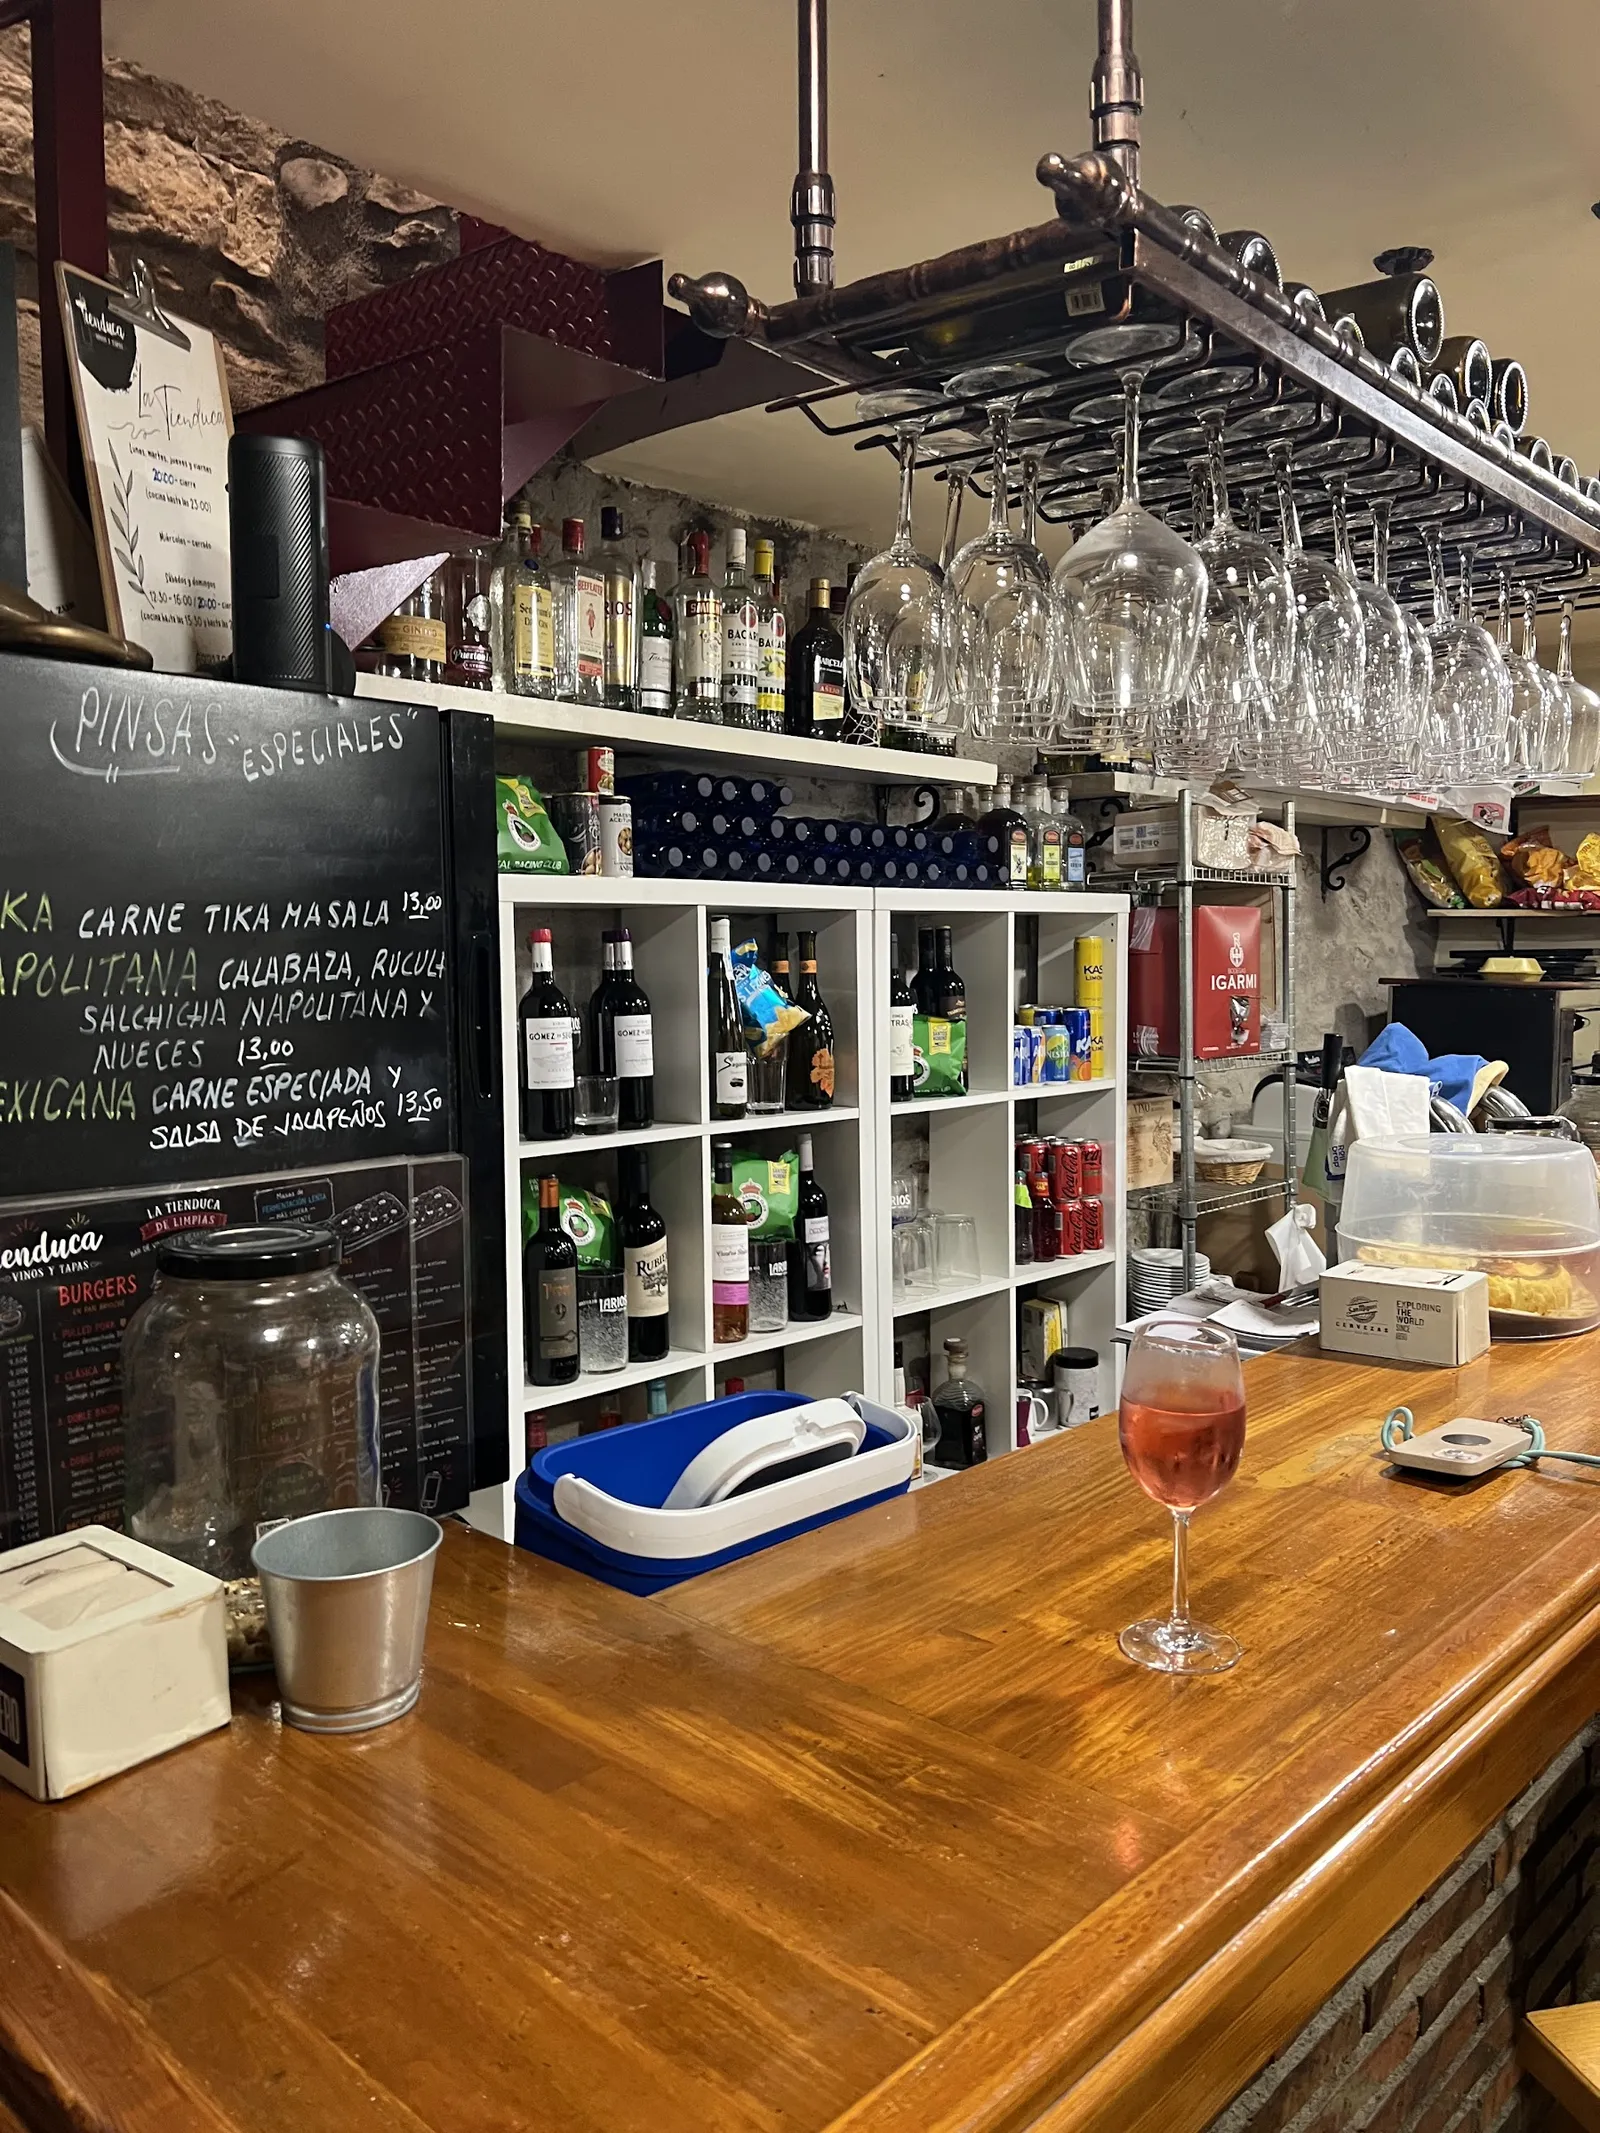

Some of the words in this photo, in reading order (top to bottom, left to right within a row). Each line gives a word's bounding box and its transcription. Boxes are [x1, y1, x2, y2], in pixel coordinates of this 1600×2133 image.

[154, 384, 226, 441] Tienduca
[75, 686, 222, 766] PINSAS
[79, 902, 186, 940] CARNE
[205, 901, 270, 935] TIKA
[281, 898, 390, 932] MASALA
[1211, 974, 1257, 990] IGARMI
[80, 1002, 228, 1035] SALCHICHA
[239, 991, 409, 1032] NAPOLITANA
[93, 1039, 204, 1075] NUECES
[152, 1076, 237, 1115] CARNE
[246, 1064, 372, 1103] ESPECIADA
[150, 1121, 222, 1150] SALSA
[234, 1114, 265, 1142] DE
[147, 1206, 163, 1219] LA
[165, 1198, 221, 1214] TIENDUCA
[155, 1220, 170, 1232] DE
[173, 1214, 217, 1228] LIMPIAS
[12, 1267, 44, 1282] VINOS
[48, 1266, 55, 1276] Y
[59, 1260, 90, 1274] TAPAS
[58, 1274, 138, 1307] BURGERS
[1396, 1300, 1442, 1313] EXPLORING
[1396, 1309, 1412, 1317] THE
[1335, 1321, 1389, 1334] CERVEZAS
[1396, 1316, 1425, 1326] WORLD
